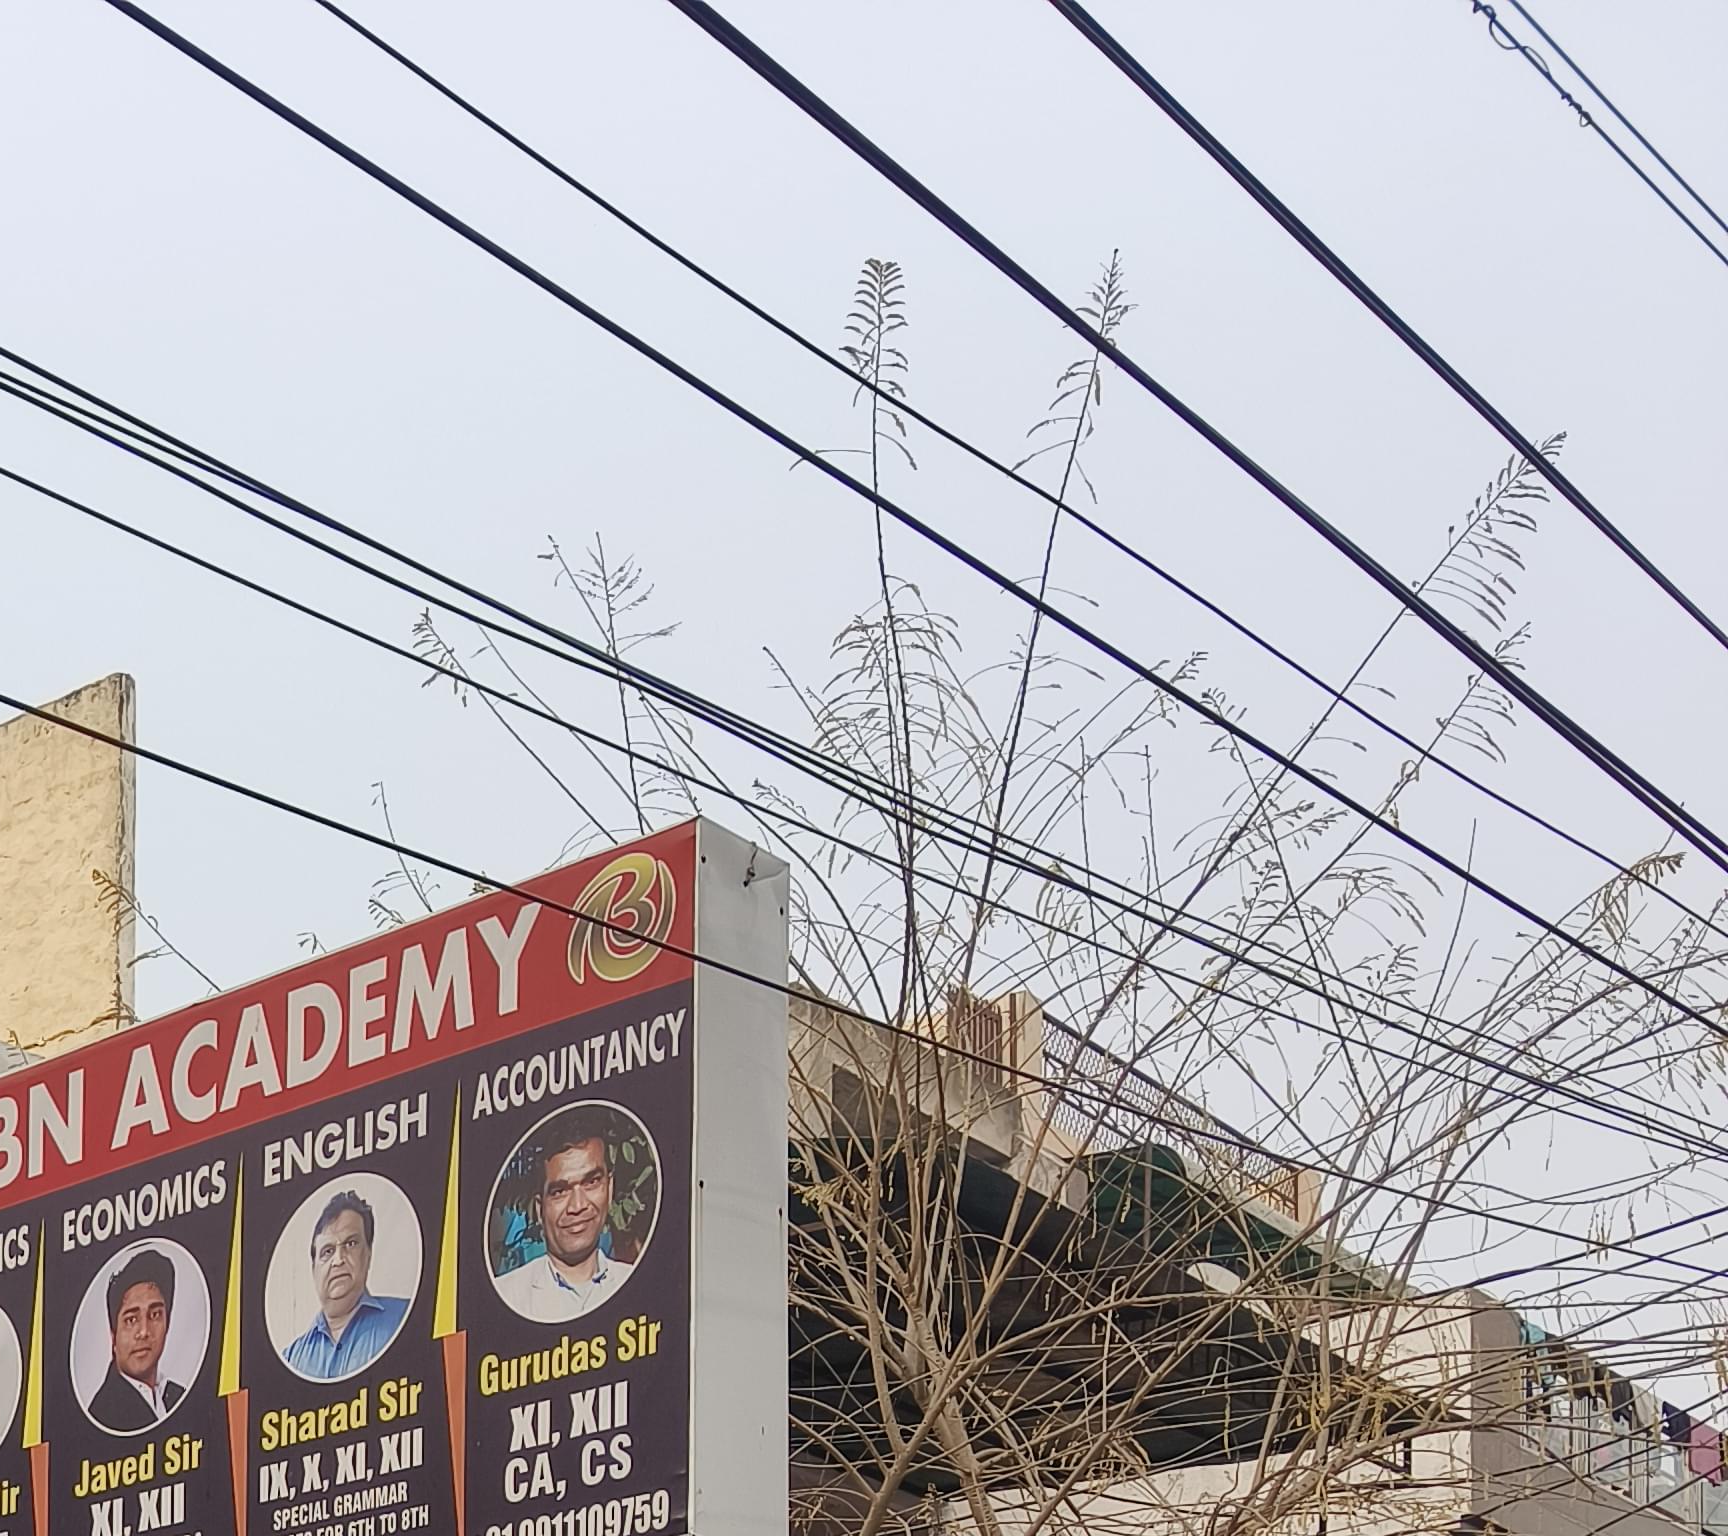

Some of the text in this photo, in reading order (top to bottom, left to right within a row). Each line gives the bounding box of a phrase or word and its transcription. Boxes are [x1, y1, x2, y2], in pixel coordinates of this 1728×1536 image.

[112, 902, 543, 1152] ACADEMY
[472, 1008, 687, 1120] ACCOUNTANCY
[263, 1092, 430, 1187] ENGLISH
[63, 1160, 227, 1252] ECONOMICS
[479, 1315, 662, 1397] Gurudas Sir
[261, 1376, 423, 1451] Sharad Sir
[509, 1380, 628, 1453] XI, XII
[75, 1433, 203, 1497] Javed Sir
[259, 1427, 424, 1504] IX, X, XI, XII
[504, 1433, 633, 1503] CA, CS
[138, 1482, 185, 1533] XII
[273, 1481, 408, 1531] SPECIAL GRAMMAR
[379, 1511, 397, 1536] TO
[401, 1504, 430, 1531] 8TH
